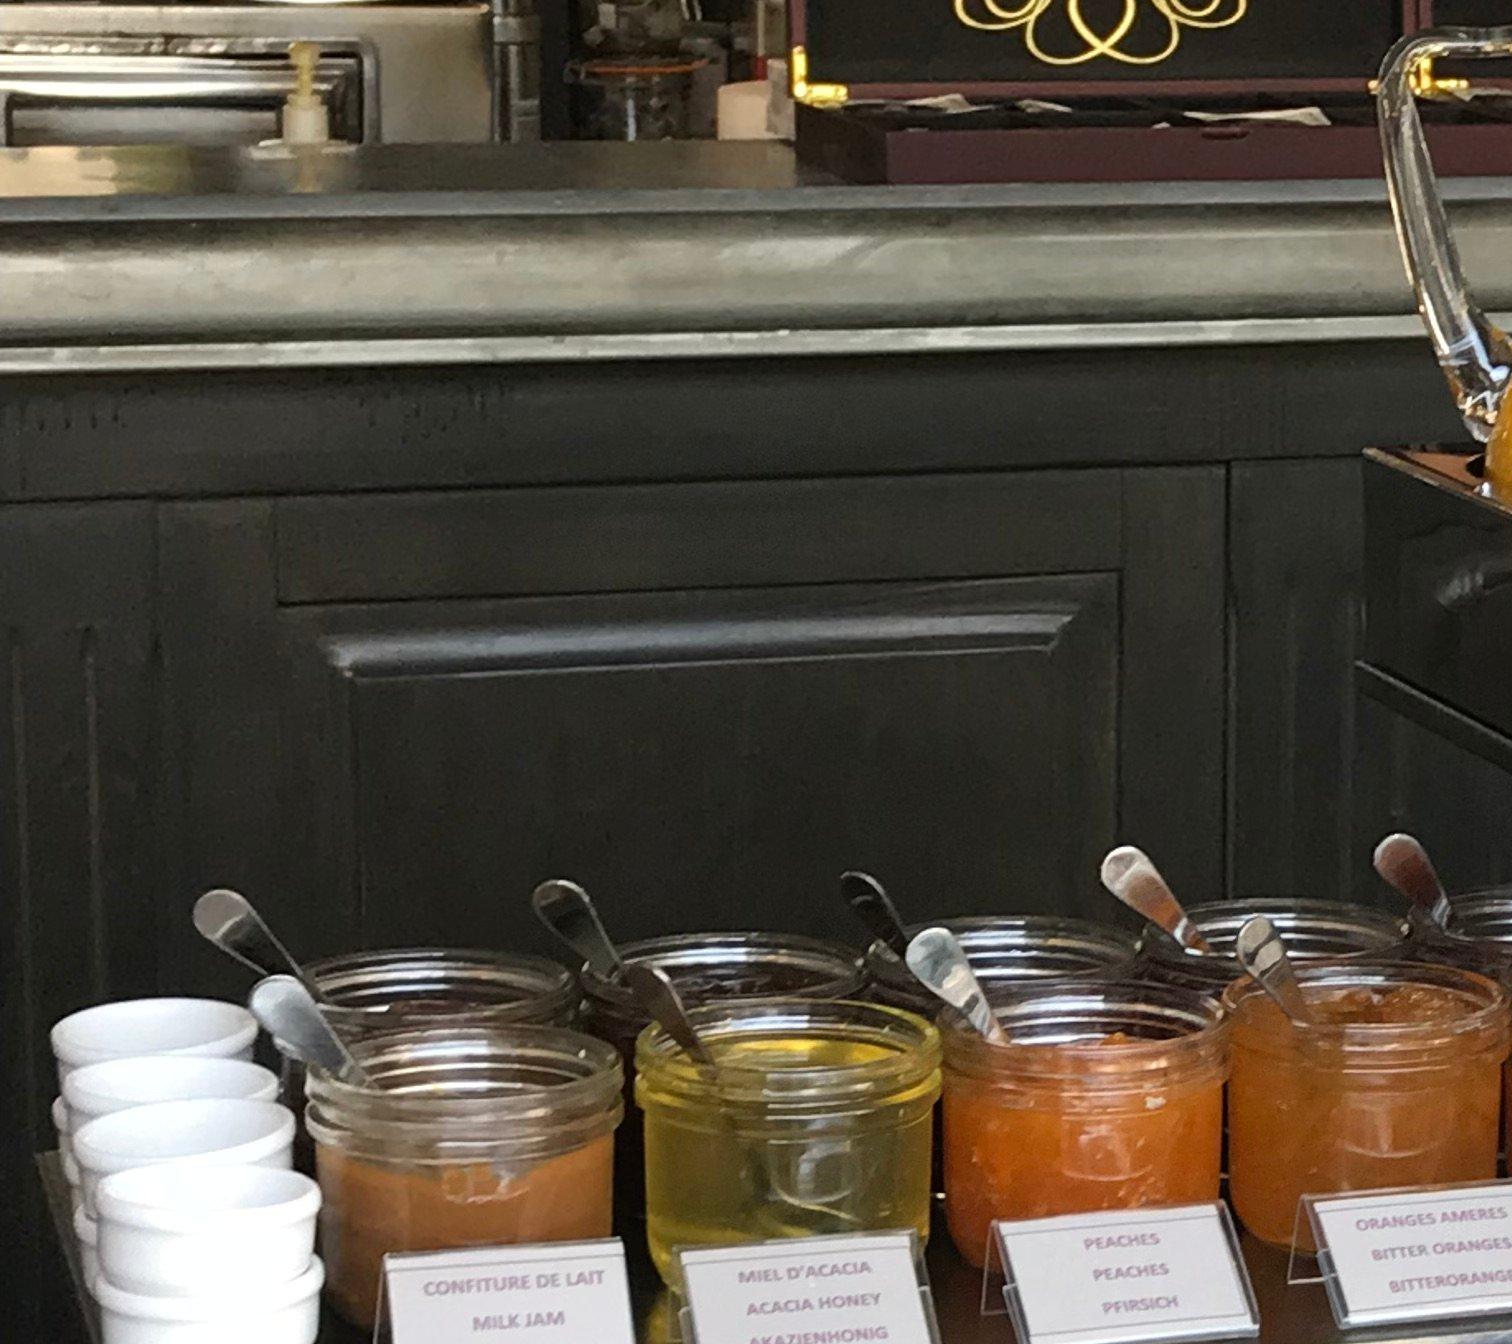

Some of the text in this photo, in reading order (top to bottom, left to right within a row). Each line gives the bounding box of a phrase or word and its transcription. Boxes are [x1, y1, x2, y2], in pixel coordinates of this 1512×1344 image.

[1355, 1212, 1436, 1232] ORANGES
[1083, 1233, 1161, 1251] PEACHES
[1371, 1244, 1428, 1261] BITTER
[738, 1261, 873, 1283] MIEL D'ACACIA
[1093, 1263, 1170, 1281] PEACHES
[423, 1270, 605, 1296] CONFITURE DE LAIT
[747, 1292, 882, 1316] ACACIA HONEY
[1101, 1294, 1180, 1315] PFIRSICH
[472, 1311, 565, 1331] MILK JAM
